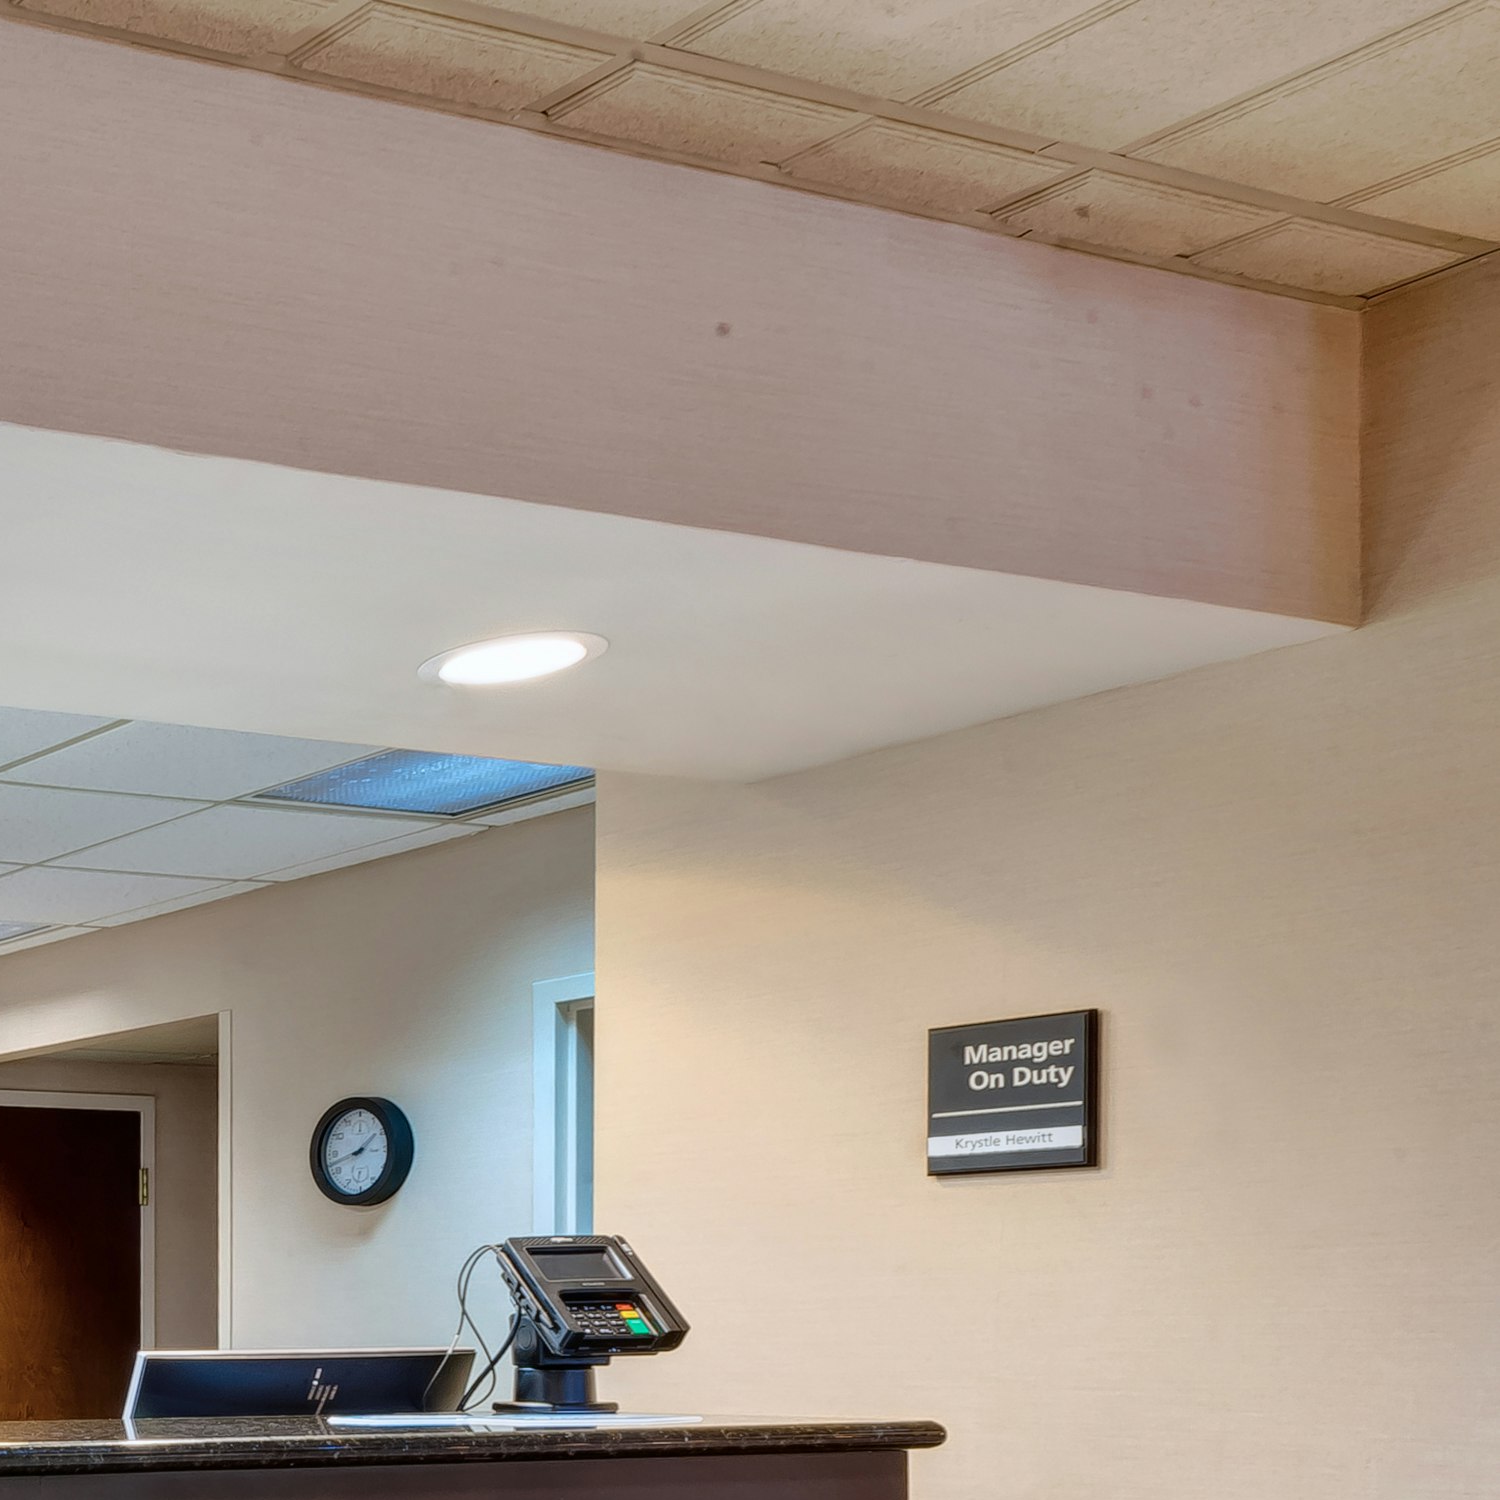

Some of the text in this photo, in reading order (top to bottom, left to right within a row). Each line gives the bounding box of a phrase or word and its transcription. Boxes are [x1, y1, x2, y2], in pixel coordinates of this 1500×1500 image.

[963, 1037, 1075, 1063] Manager
[968, 1065, 1075, 1090] On Duty
[955, 1132, 1053, 1151] Krystle Hewitt
